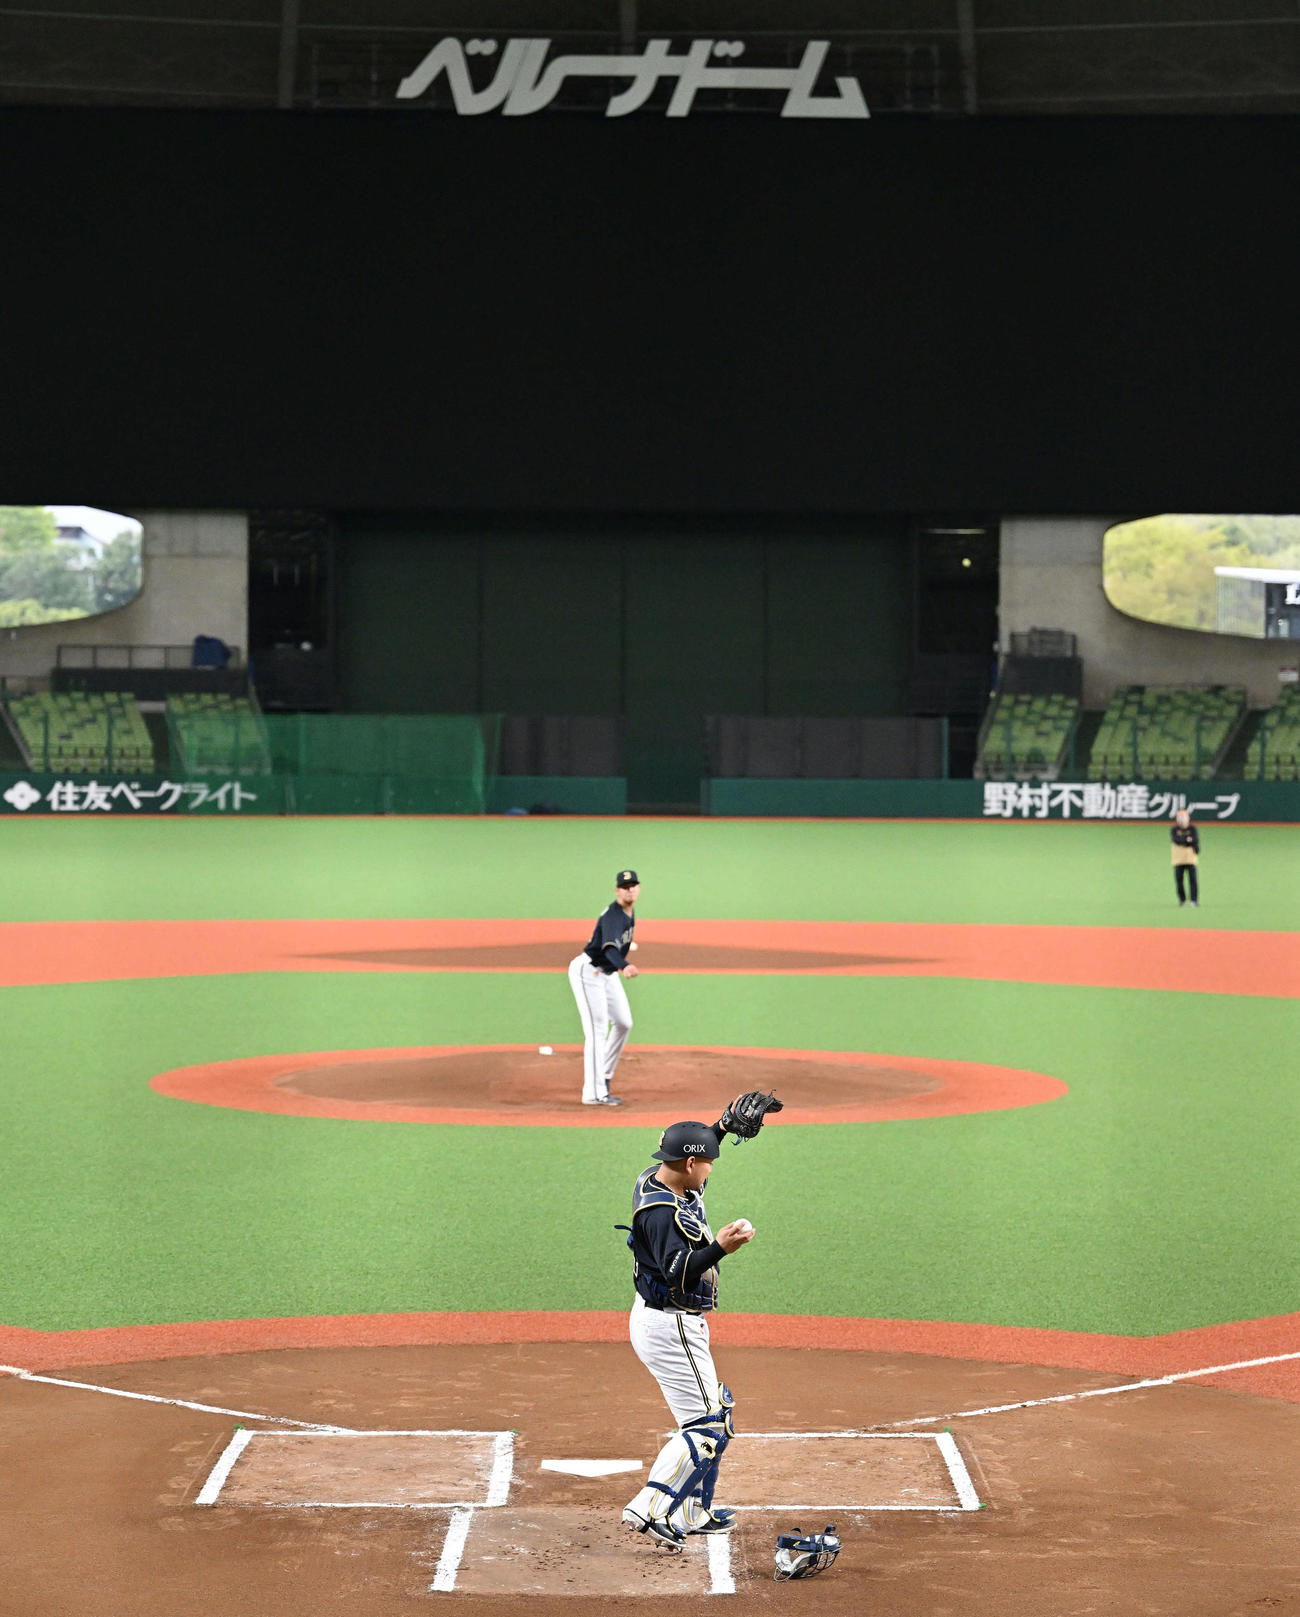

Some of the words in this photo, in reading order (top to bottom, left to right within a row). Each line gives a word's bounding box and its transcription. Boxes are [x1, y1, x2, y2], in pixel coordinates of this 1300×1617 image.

[46, 780, 257, 810] 住友ベークライト
[983, 782, 1240, 818] 野村不動産グループ
[683, 1144, 706, 1153] ORIX
